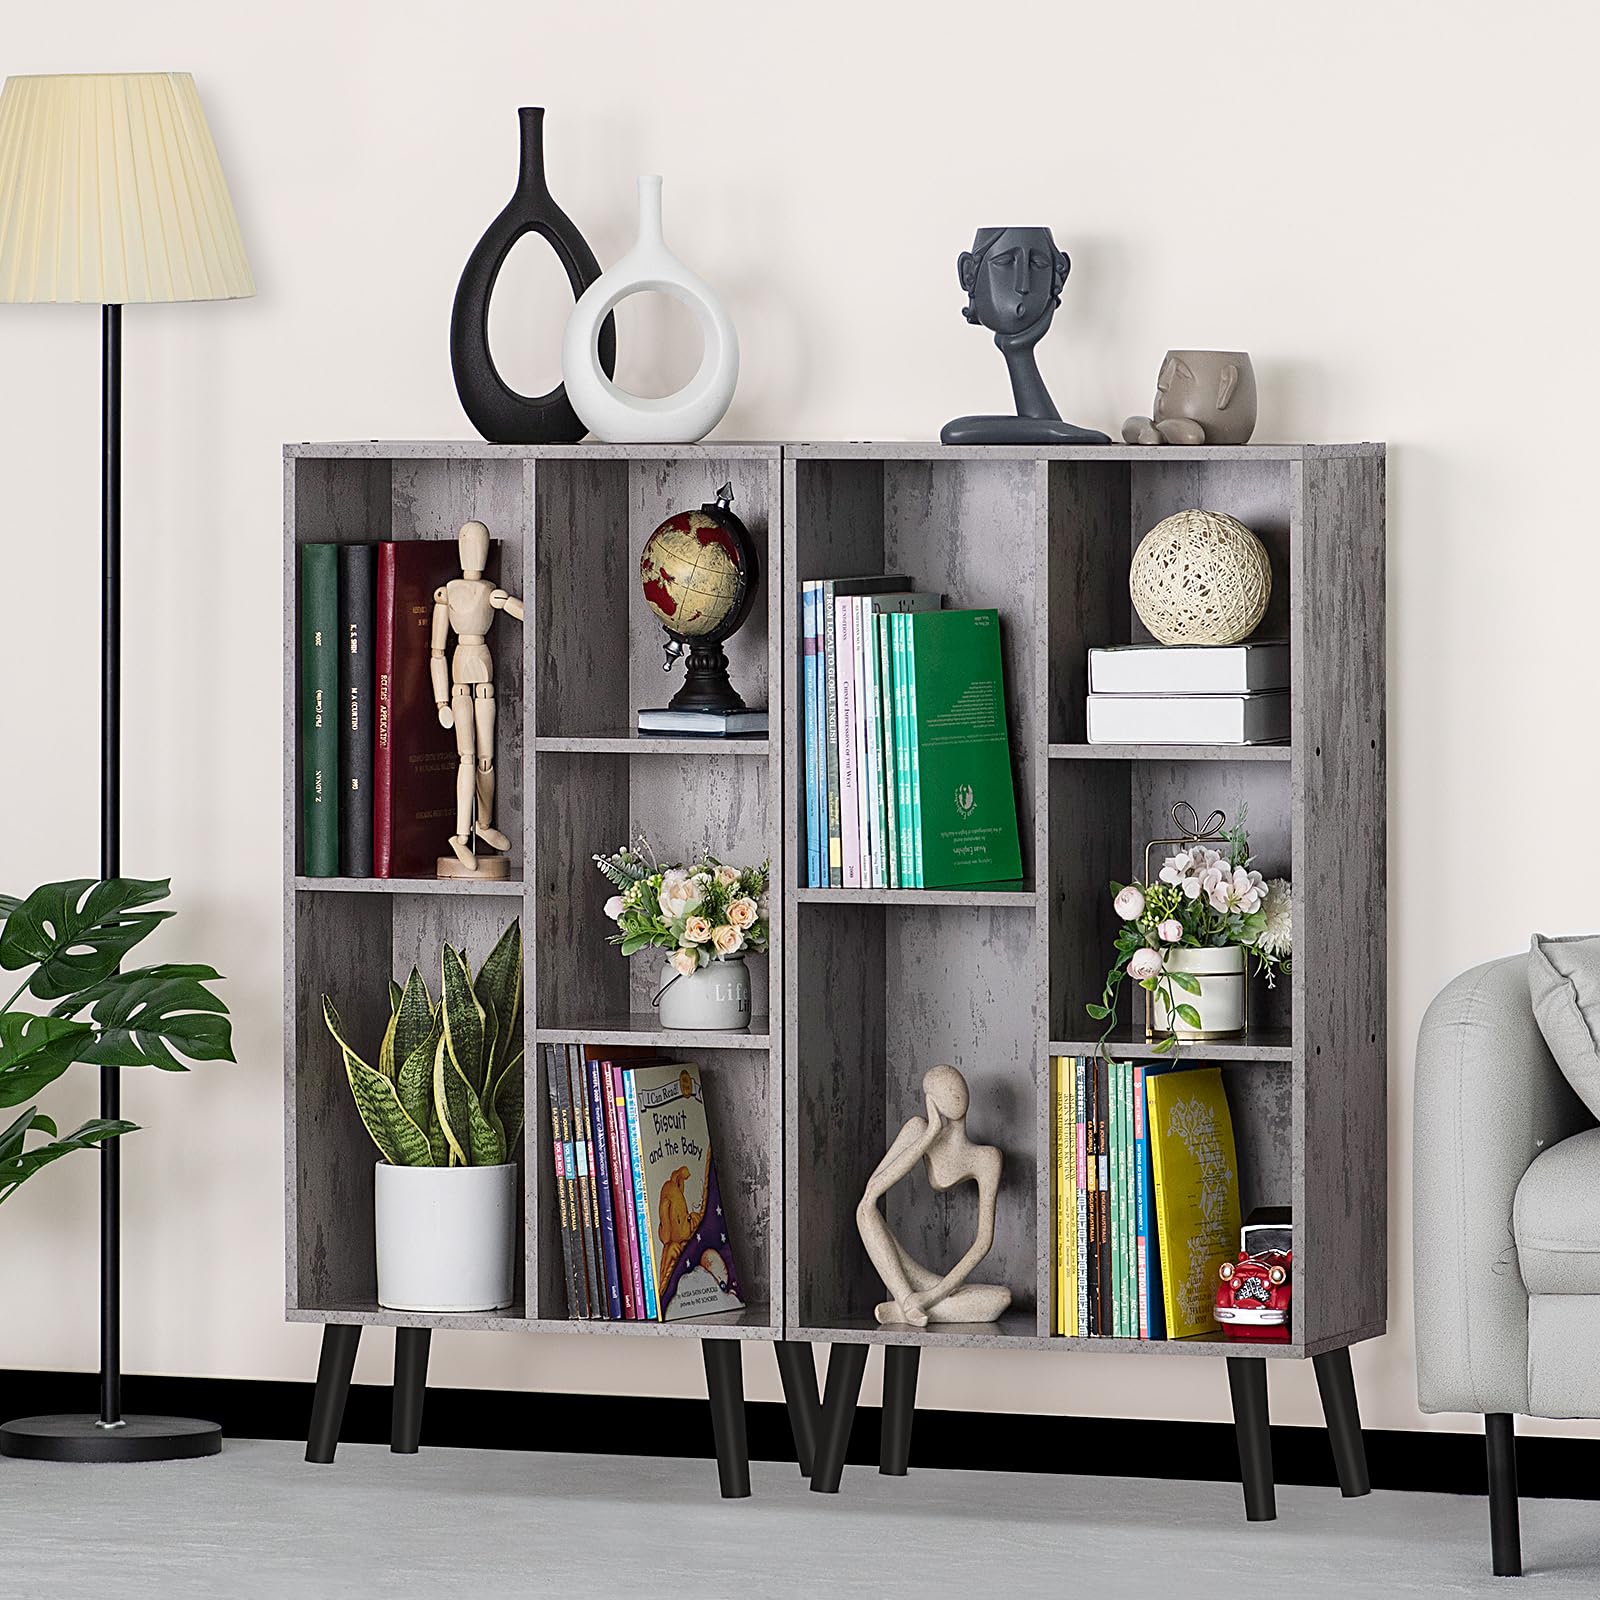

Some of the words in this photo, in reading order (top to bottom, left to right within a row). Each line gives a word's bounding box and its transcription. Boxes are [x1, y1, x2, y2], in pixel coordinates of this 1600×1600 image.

[825, 593, 834, 620] FROM
[826, 622, 835, 652] LOCAL
[828, 654, 835, 666] TO
[828, 667, 836, 704] GLOBAL
[829, 706, 837, 744] ENGLISH
[714, 983, 748, 1002] Life
[647, 1092, 651, 1104] I
[651, 1092, 663, 1105] Can
[575, 1116, 583, 1138] JOURNAL
[653, 1110, 688, 1136] Biscuit
[630, 1123, 642, 1158] JOURNAL
[649, 1141, 664, 1164] and
[665, 1138, 680, 1156] the
[681, 1136, 703, 1161] Baby
[635, 1177, 644, 1195] ASIA
[1138, 1196, 1143, 1204] OF
[560, 1199, 568, 1228] AUSTRALIA
[569, 1202, 577, 1231] AUSTRALIA
[582, 1199, 590, 1228] AUSTRALIA
[637, 1198, 647, 1217] TEFL
[1138, 1245, 1147, 1295] WORLD-WIDE
[1139, 1295, 1148, 1329] ENGLISH
